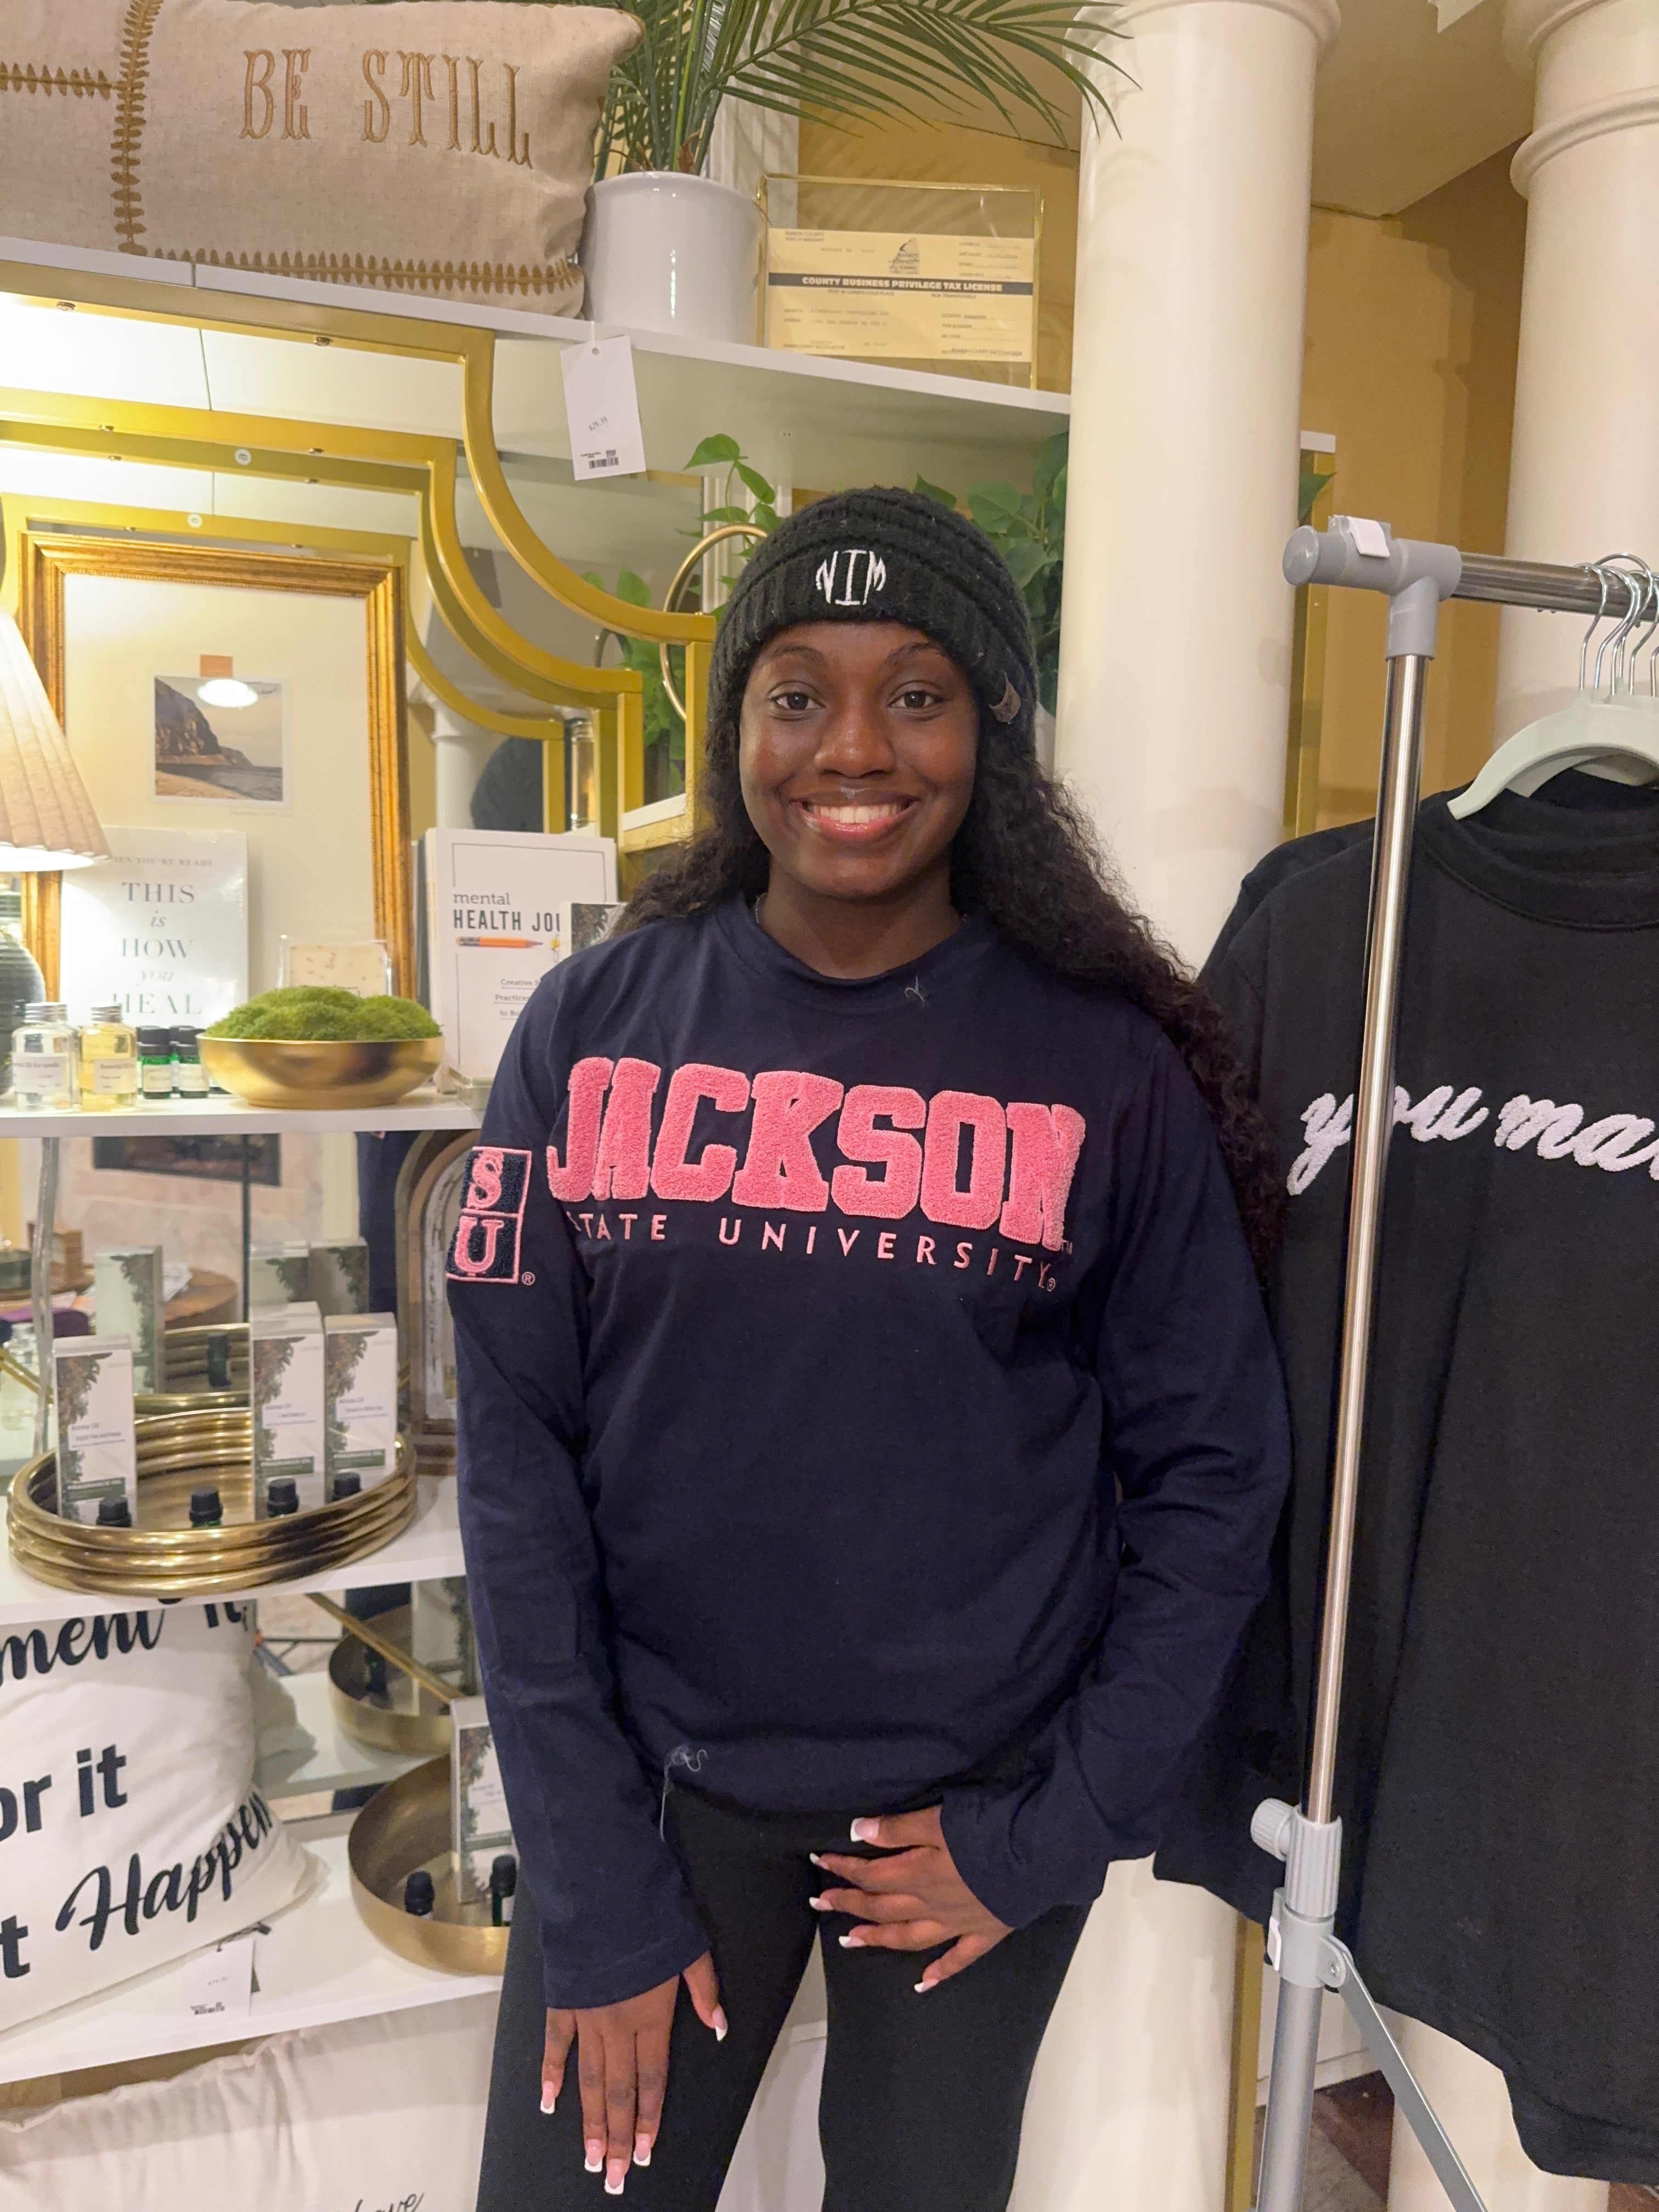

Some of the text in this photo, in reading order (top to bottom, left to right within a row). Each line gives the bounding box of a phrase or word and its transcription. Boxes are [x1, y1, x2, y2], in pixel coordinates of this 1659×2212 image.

[239, 48, 534, 170] BE STILL
[802, 276, 841, 286] COUNTY
[842, 278, 890, 287] BUSINESS
[891, 280, 942, 290] PRIVILEGE
[963, 283, 1003, 292] LICENSE
[179, 859, 213, 867] READY
[121, 882, 195, 905] THIS
[453, 892, 511, 906] mental
[150, 910, 167, 928] is
[453, 909, 522, 932] HEALTH
[121, 938, 195, 959] HOW
[136, 970, 175, 986] you
[111, 992, 202, 1015] HEAL
[1494, 1094, 1659, 1181] ma
[546, 1056, 1086, 1251] JACKSON
[76, 1744, 128, 1818] it
[55, 1791, 273, 1951] Happen
